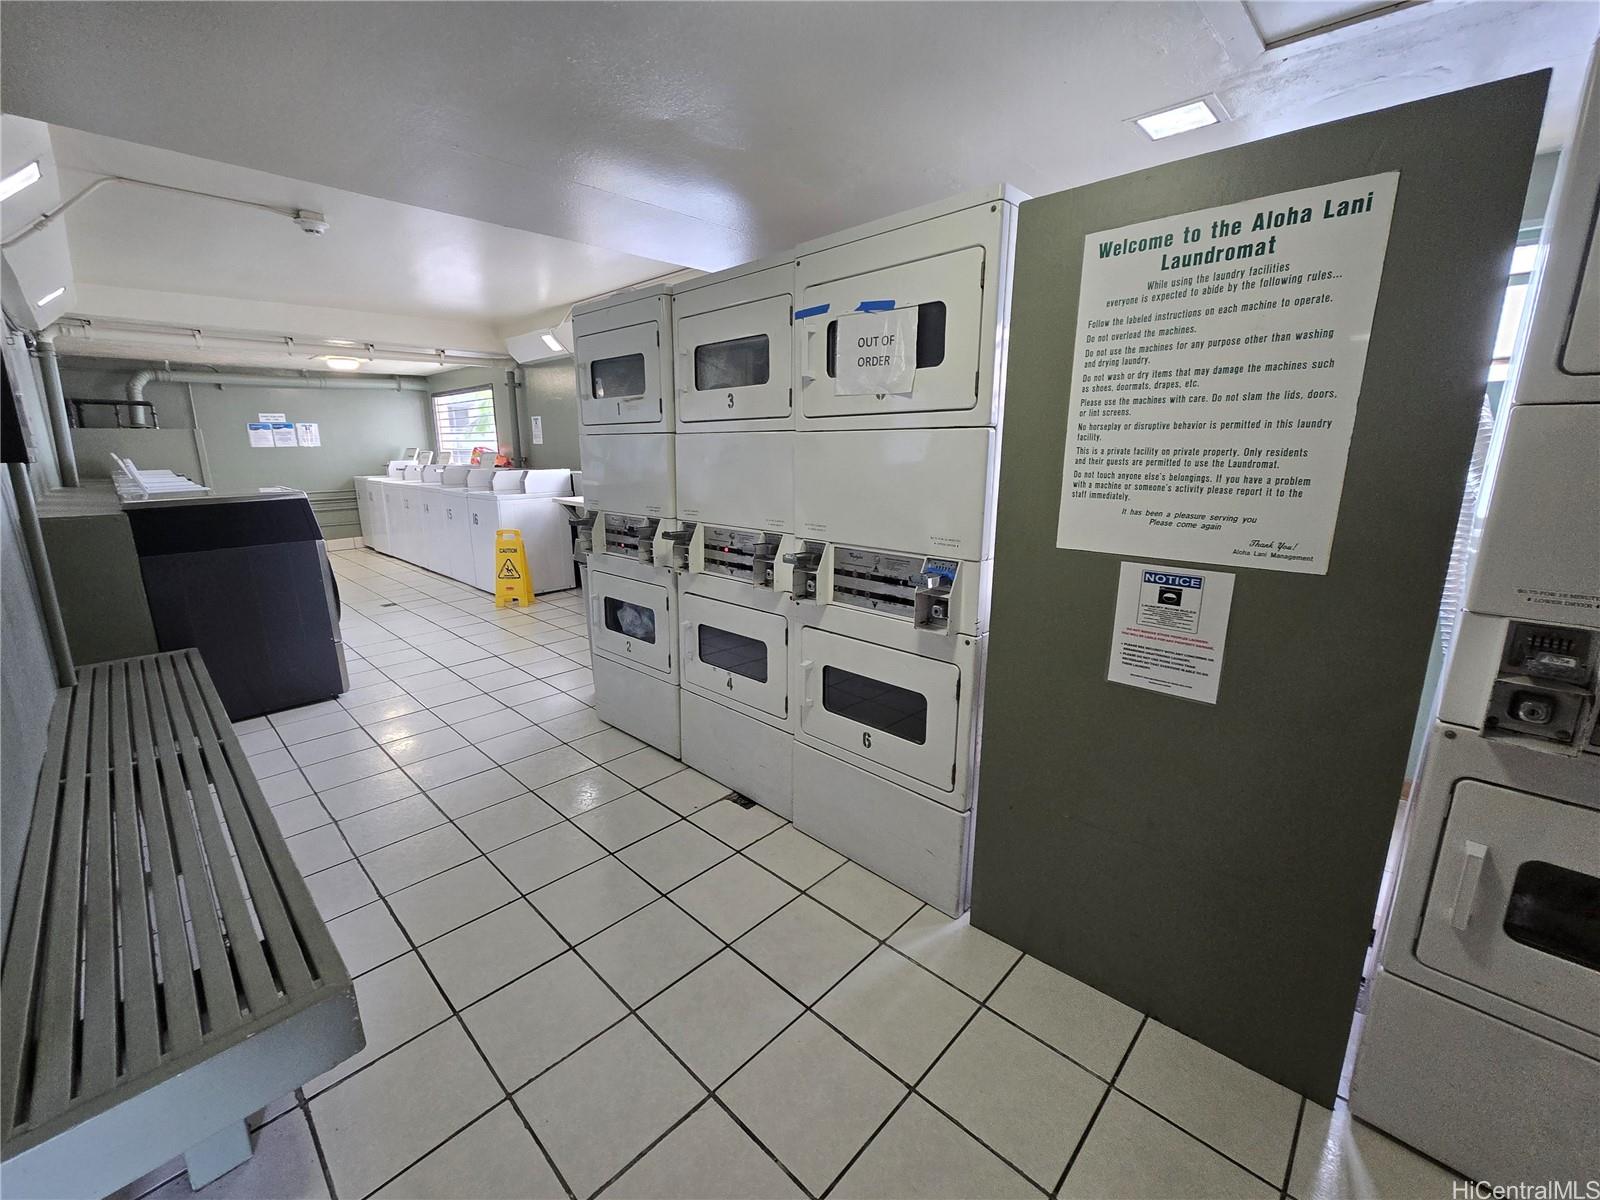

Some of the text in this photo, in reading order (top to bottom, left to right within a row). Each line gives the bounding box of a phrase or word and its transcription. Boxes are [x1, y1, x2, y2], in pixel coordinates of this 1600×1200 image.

[1099, 191, 1374, 259] Welcome to the Aloha Lani
[1161, 235, 1276, 271] Laundromat
[1147, 262, 1290, 290] While using the laundry facilities
[1106, 270, 1342, 308] everyone is expected to abide by the following rules...
[1087, 293, 1333, 329] Follow the labeled instructions on each machine to operate.
[858, 335, 895, 348] OUT OF
[1084, 328, 1334, 358] Do not use the machines for any purpose other than washing
[858, 356, 890, 367] ORDER
[1082, 374, 1092, 383] Do
[1093, 373, 1105, 382] not
[1107, 372, 1125, 381] wash
[1137, 370, 1149, 380] dry
[1151, 370, 1173, 378] items
[1175, 367, 1191, 377] that
[1193, 368, 1210, 377] may
[1212, 365, 1244, 375] damage
[1247, 363, 1262, 373] the
[1264, 360, 1308, 372] machines
[1311, 358, 1335, 369] such
[1184, 378, 1200, 388] etc.
[728, 393, 734, 408] 3
[1080, 398, 1102, 407] Please
[1118, 397, 1130, 406] the
[1132, 395, 1167, 405] machines
[1169, 394, 1186, 404] with
[1188, 395, 1208, 403] care.
[1211, 393, 1222, 402] Do
[1225, 392, 1239, 402] not
[1242, 391, 1263, 402] slam
[1266, 391, 1280, 401] the
[1077, 423, 1087, 431] No
[1088, 422, 1122, 432] horseplay
[1133, 421, 1170, 431] disruptive
[1173, 420, 1207, 430] behavior
[1209, 420, 1217, 429] is
[1219, 419, 1262, 431] permitted
[1264, 419, 1273, 429] in
[1276, 418, 1294, 429] this
[1296, 418, 1333, 429] laundry
[1076, 446, 1090, 455] This
[1091, 447, 1098, 455] is
[1106, 447, 1131, 456] private
[1133, 447, 1159, 457] facility
[1172, 447, 1200, 457] private
[1202, 448, 1240, 458] property.
[1243, 447, 1263, 458] Only
[1265, 447, 1308, 457] residents
[1074, 456, 1087, 465] and
[1088, 456, 1104, 465] their
[1106, 457, 1130, 467] guests
[1145, 458, 1182, 468] permitted
[1183, 458, 1192, 467] to
[1211, 458, 1225, 468] the
[1227, 458, 1280, 469] Laundromat.
[1073, 470, 1082, 478] Do
[1096, 471, 1116, 479] touch
[1117, 473, 1142, 481] anyone
[1144, 472, 1166, 481] else's
[1168, 472, 1213, 484] belongings.
[1215, 474, 1223, 483] If
[1225, 476, 1240, 485] you
[1242, 474, 1263, 484] have
[1274, 476, 1311, 486] problem
[1072, 480, 1087, 488] with
[1094, 481, 1122, 490] machine
[1134, 483, 1172, 492] someone's
[1174, 484, 1205, 495] activity
[1206, 485, 1234, 495] please
[1236, 487, 1263, 497] report
[1265, 487, 1273, 497] it
[1276, 488, 1285, 497] to
[1288, 488, 1303, 498] the
[472, 513, 478, 525] 16
[1145, 509, 1163, 517] been
[1172, 511, 1206, 520] pleasure
[1209, 514, 1239, 524] serving
[1148, 518, 1174, 527] Please
[1200, 522, 1222, 531] again
[1248, 539, 1298, 551] Thank You!
[1270, 552, 1314, 562] Management
[1144, 573, 1201, 587] NOTICE
[626, 641, 631, 652] 2
[726, 678, 733, 690] 4
[863, 732, 871, 748] 6
